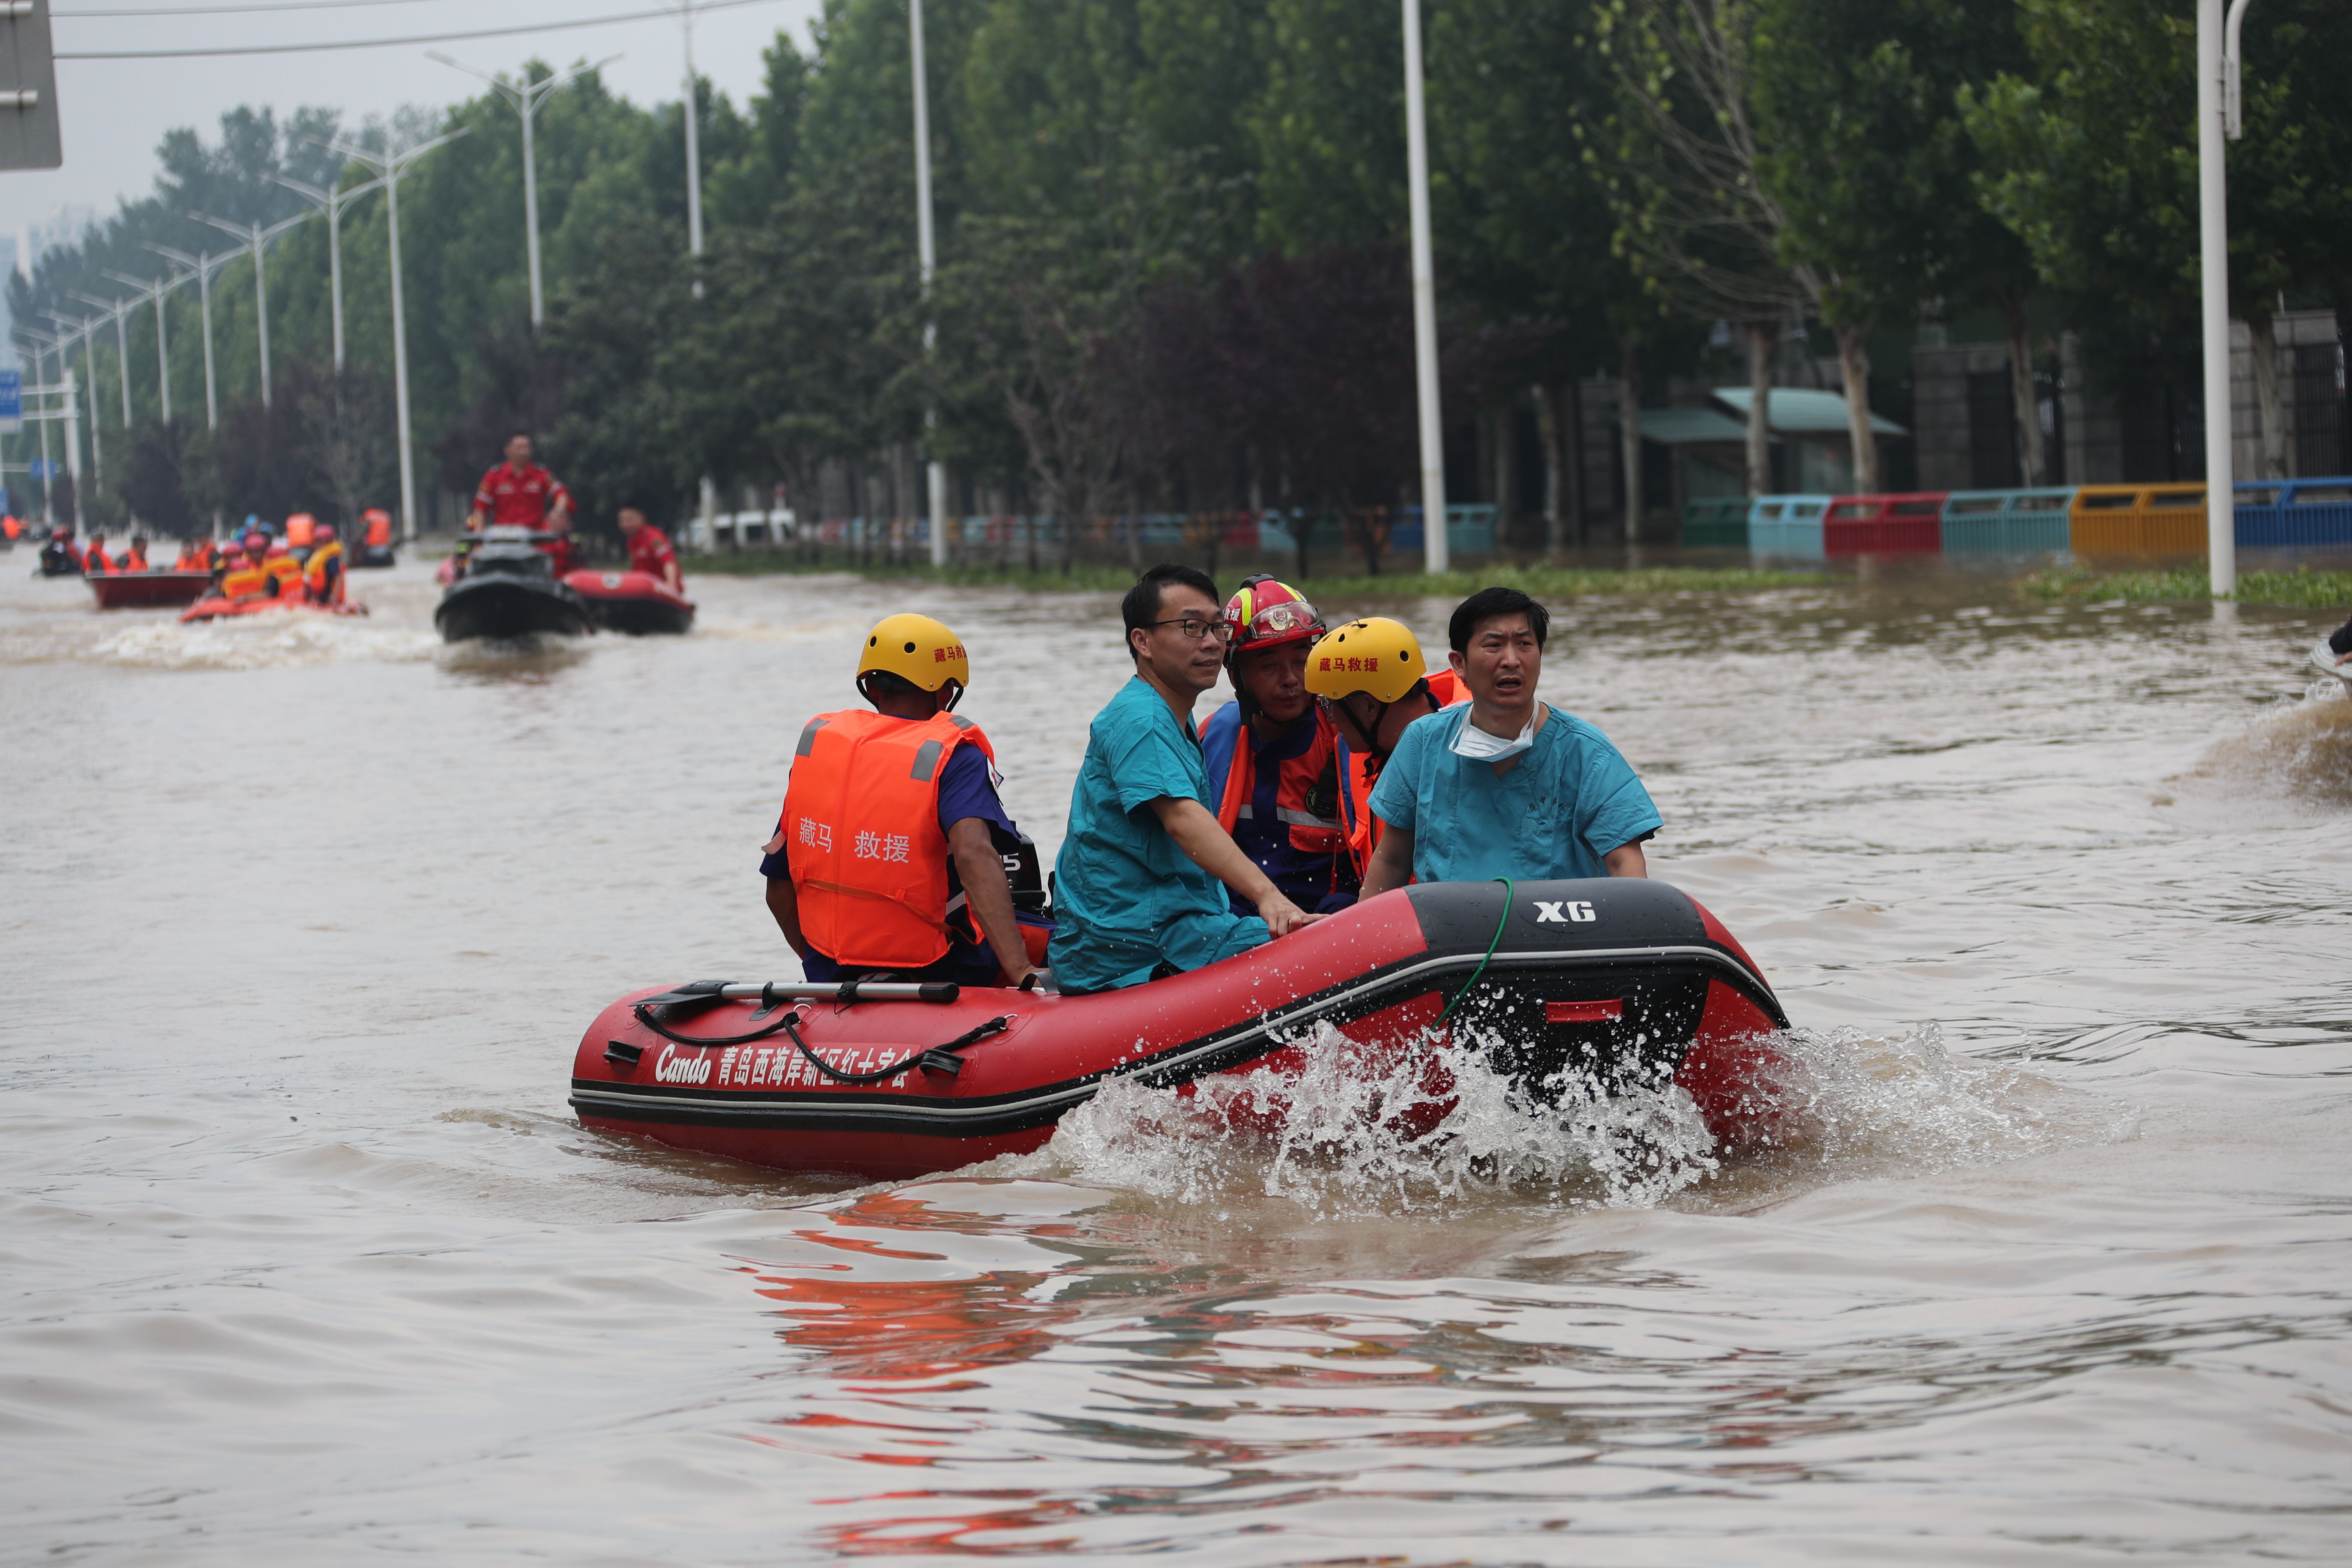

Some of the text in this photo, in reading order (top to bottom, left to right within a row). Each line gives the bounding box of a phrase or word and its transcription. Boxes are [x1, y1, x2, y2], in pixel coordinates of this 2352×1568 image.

[1319, 657, 1378, 672] 藏马救援
[799, 817, 910, 864] 藏马 救援
[1532, 901, 1596, 922] XG
[655, 1043, 711, 1084] Cando
[718, 1046, 911, 1089] 青岛西海岸新区红十字会
